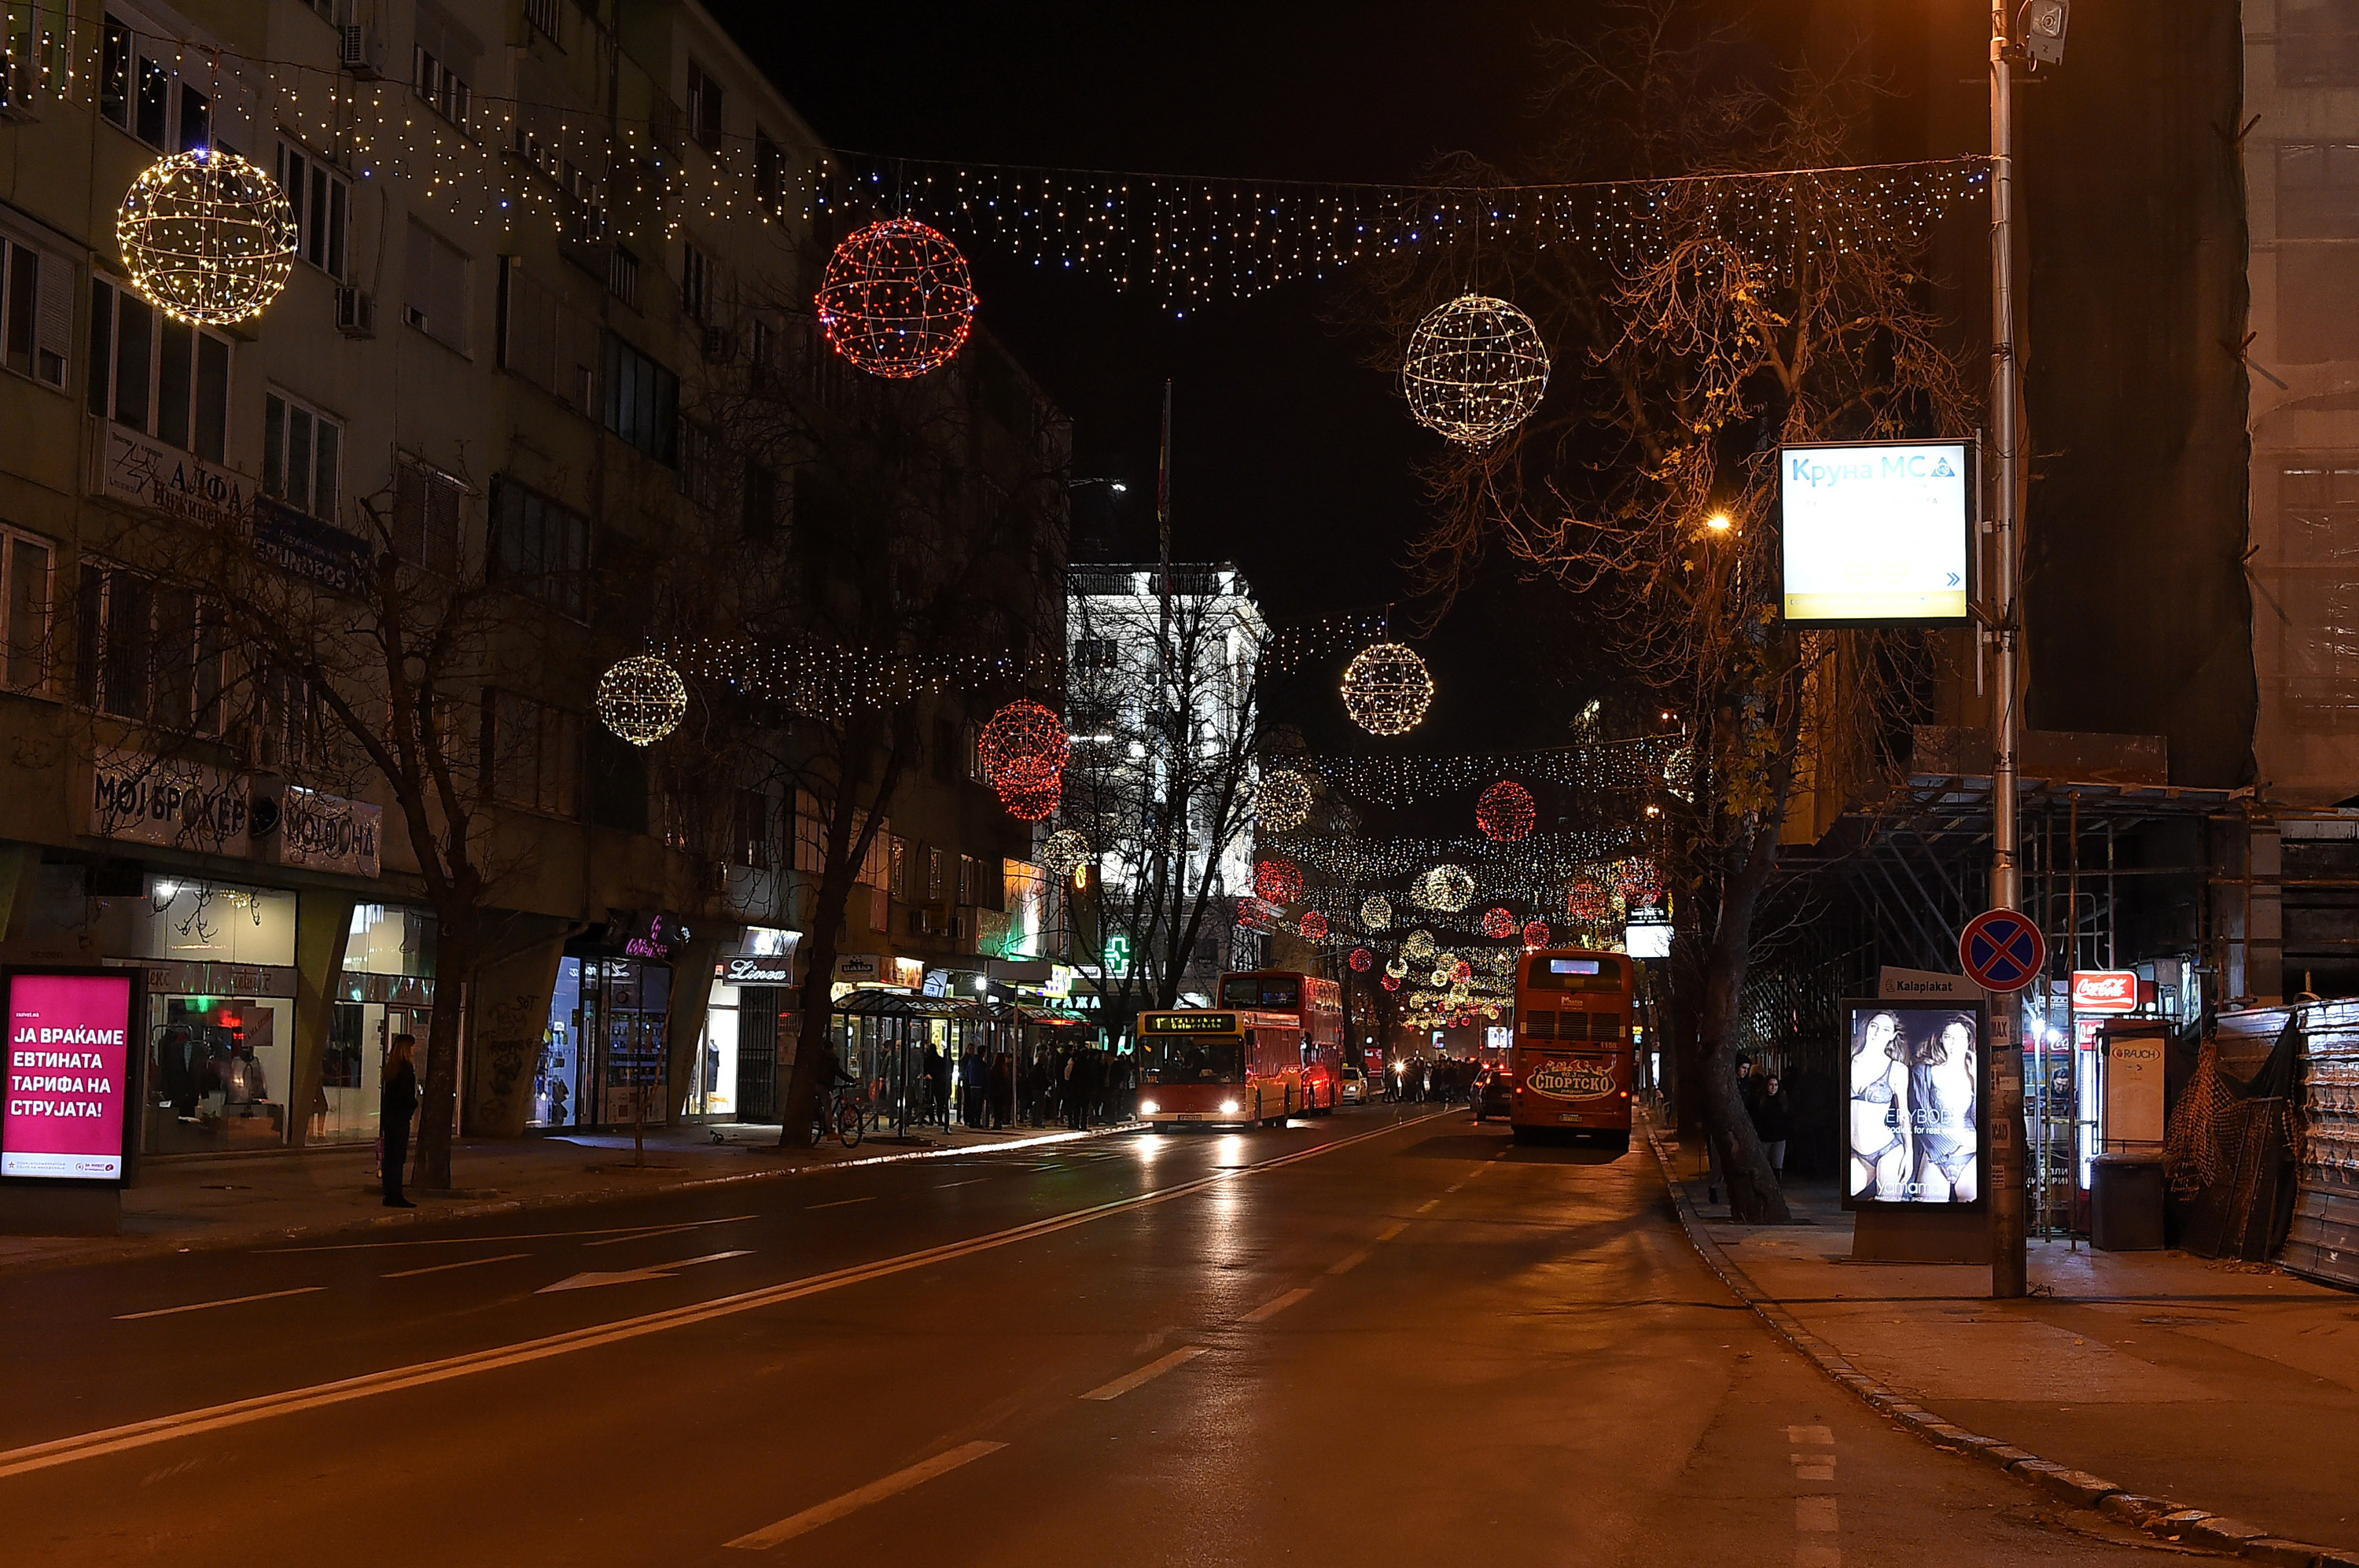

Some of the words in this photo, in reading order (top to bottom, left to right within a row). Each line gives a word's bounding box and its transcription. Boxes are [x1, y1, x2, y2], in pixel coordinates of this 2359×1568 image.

[1792, 458, 1873, 488] Круна
[1881, 456, 1927, 479] МС
[170, 461, 244, 511] АЛФА
[94, 774, 145, 816] МОЈ
[151, 786, 248, 834] БРОКЕР
[326, 816, 375, 857] ФОНД
[727, 959, 787, 981] Linea
[1897, 981, 1953, 994] Kalaplakat
[2076, 977, 2127, 997] Coca-Cola
[13, 1027, 38, 1043] ЈА
[39, 1024, 124, 1045] ВРАЌАМЕ
[13, 1051, 104, 1069] ЕВТИНАТА
[2123, 1048, 2156, 1059] RAUCH
[11, 1075, 84, 1093] ТАРИФА
[87, 1077, 112, 1094] НА
[1535, 1074, 1610, 1092] СПОРТСКО
[10, 1099, 103, 1117] СТРУЈАТА!
